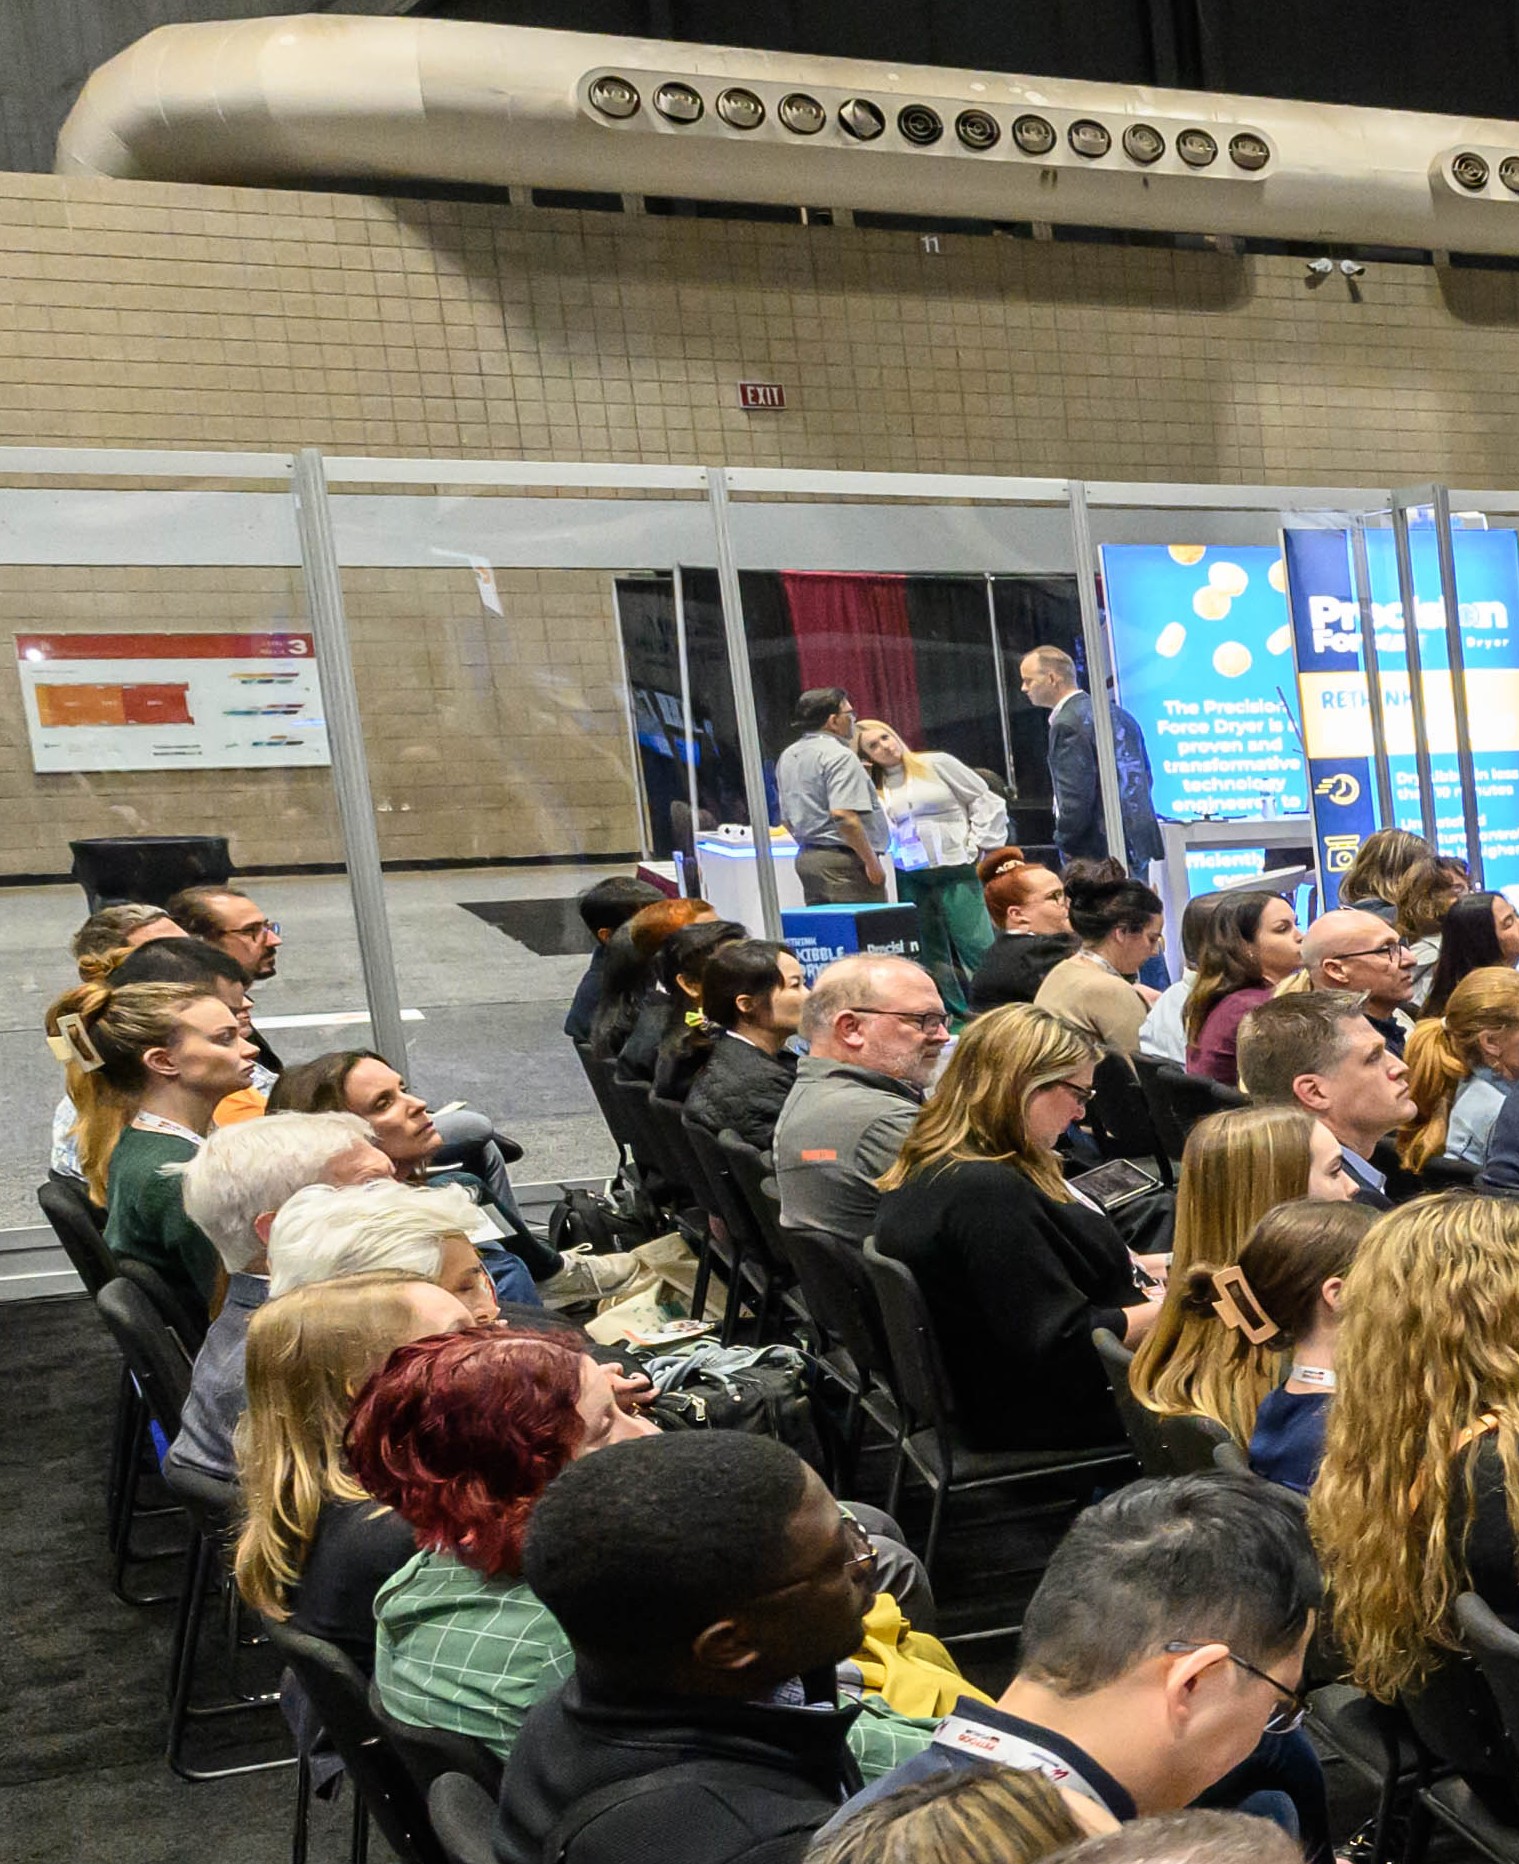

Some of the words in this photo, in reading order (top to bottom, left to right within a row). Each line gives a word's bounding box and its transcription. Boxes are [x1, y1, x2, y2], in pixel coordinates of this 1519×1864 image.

[746, 386, 779, 406] EXIT
[288, 639, 308, 655] 3
[1163, 700, 1199, 716] The
[1156, 719, 1210, 736] Force
[1214, 718, 1265, 737] Dryer
[1177, 738, 1243, 757] proven
[1247, 735, 1284, 753] and
[1163, 755, 1302, 775] transformative
[1182, 776, 1287, 793] technology
[1281, 793, 1302, 808] to
